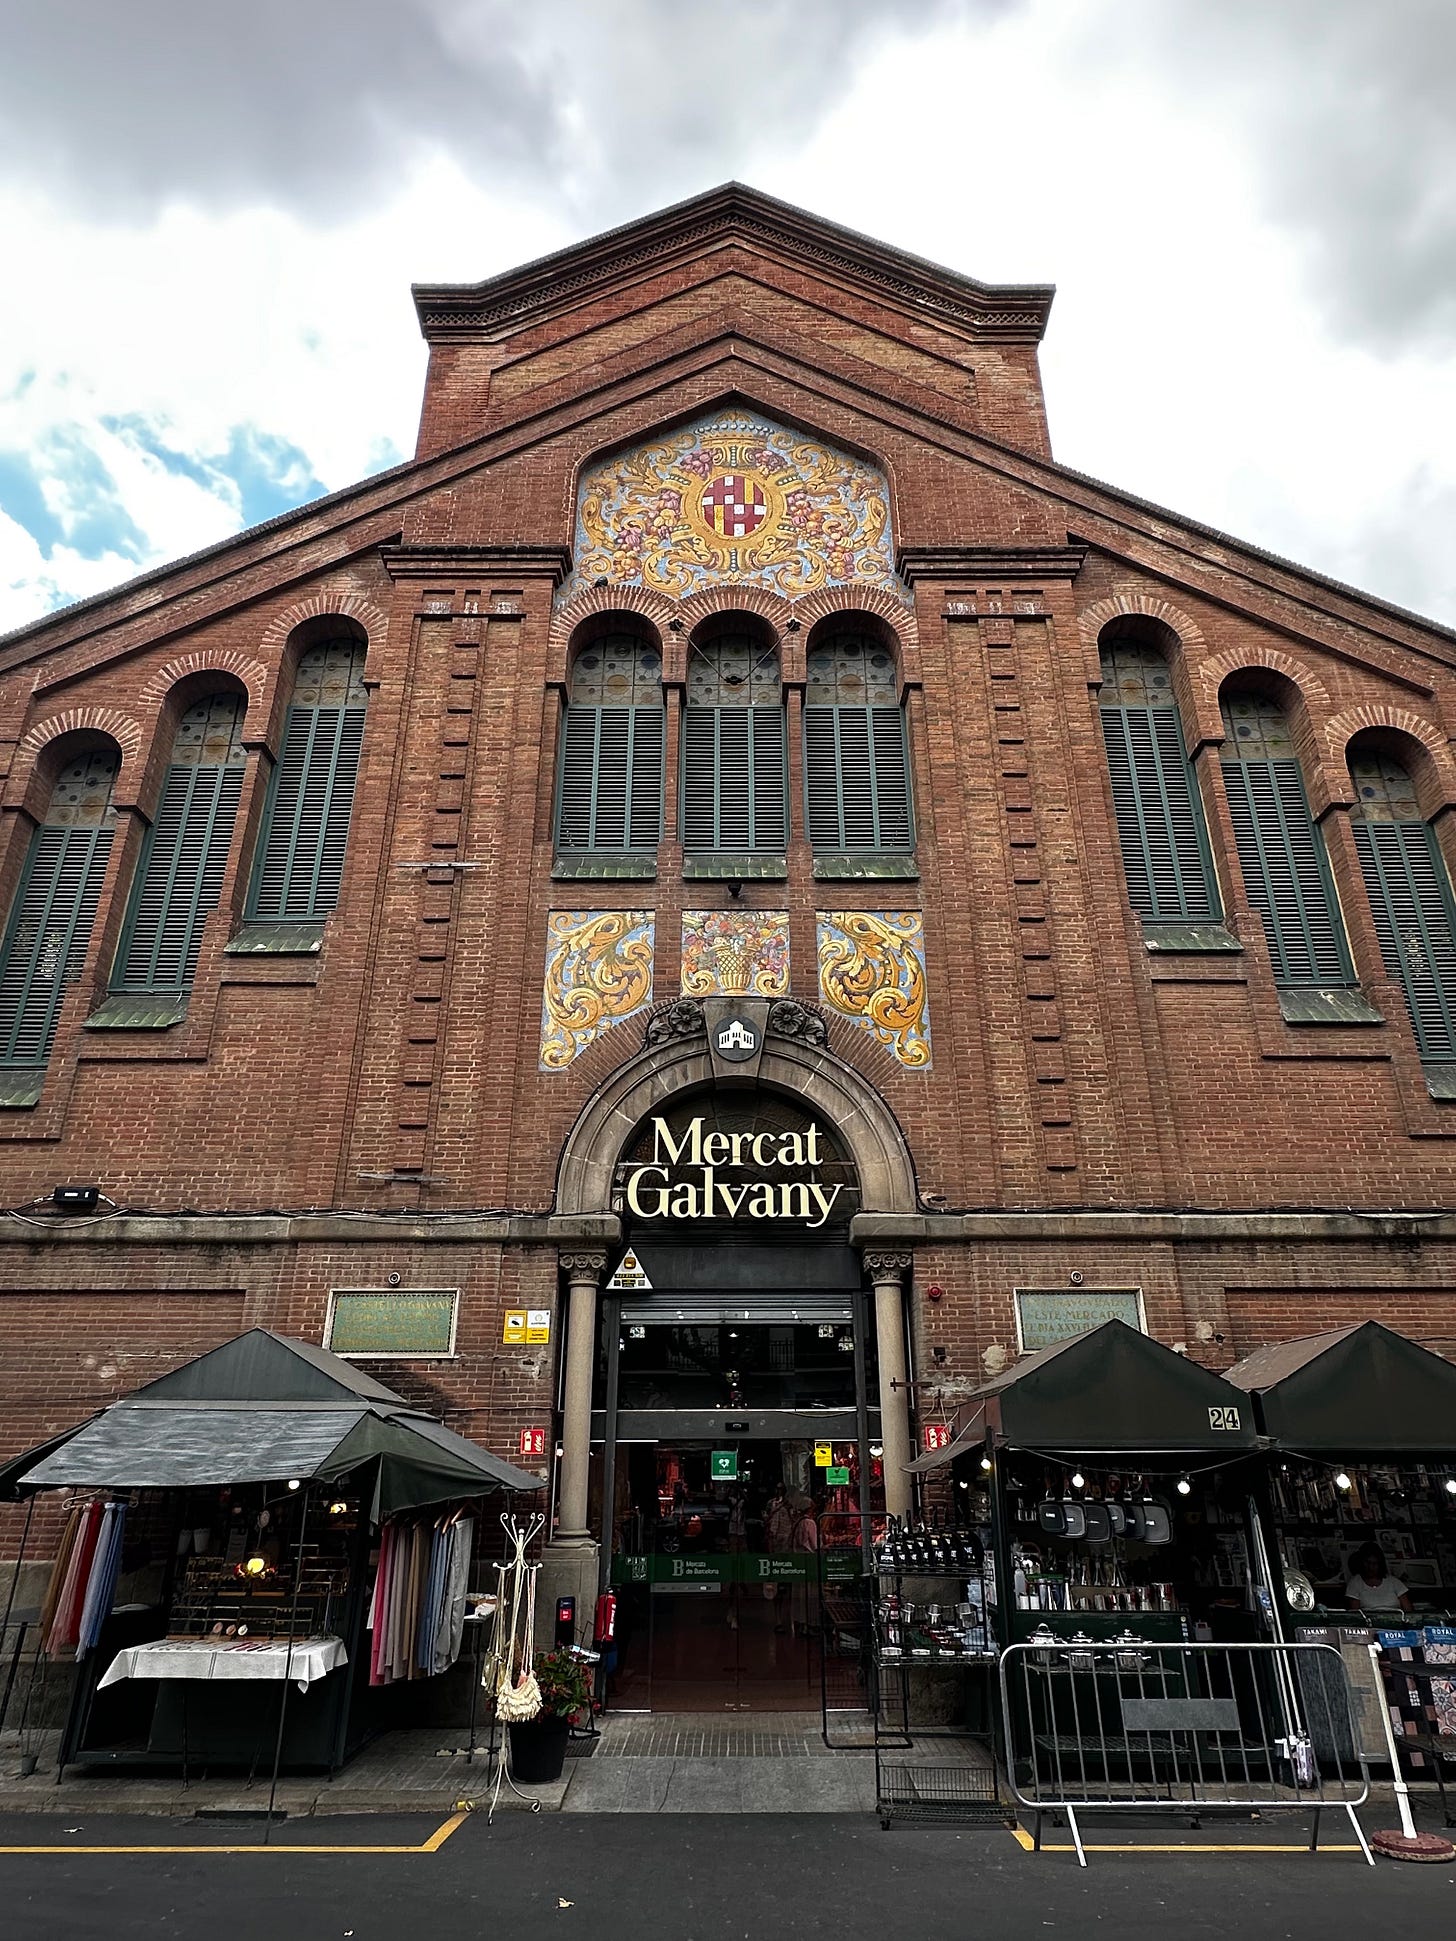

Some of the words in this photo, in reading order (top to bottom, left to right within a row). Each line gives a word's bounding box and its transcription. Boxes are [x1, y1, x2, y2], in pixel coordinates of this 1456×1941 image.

[651, 1117, 823, 1166] Mercat
[627, 1166, 844, 1228] Galvany
[1035, 1310, 1061, 1320] ESTE
[1066, 1310, 1125, 1320] MERCADO
[1210, 1408, 1239, 1429] 24
[1431, 1628, 1454, 1636] ROYAL
